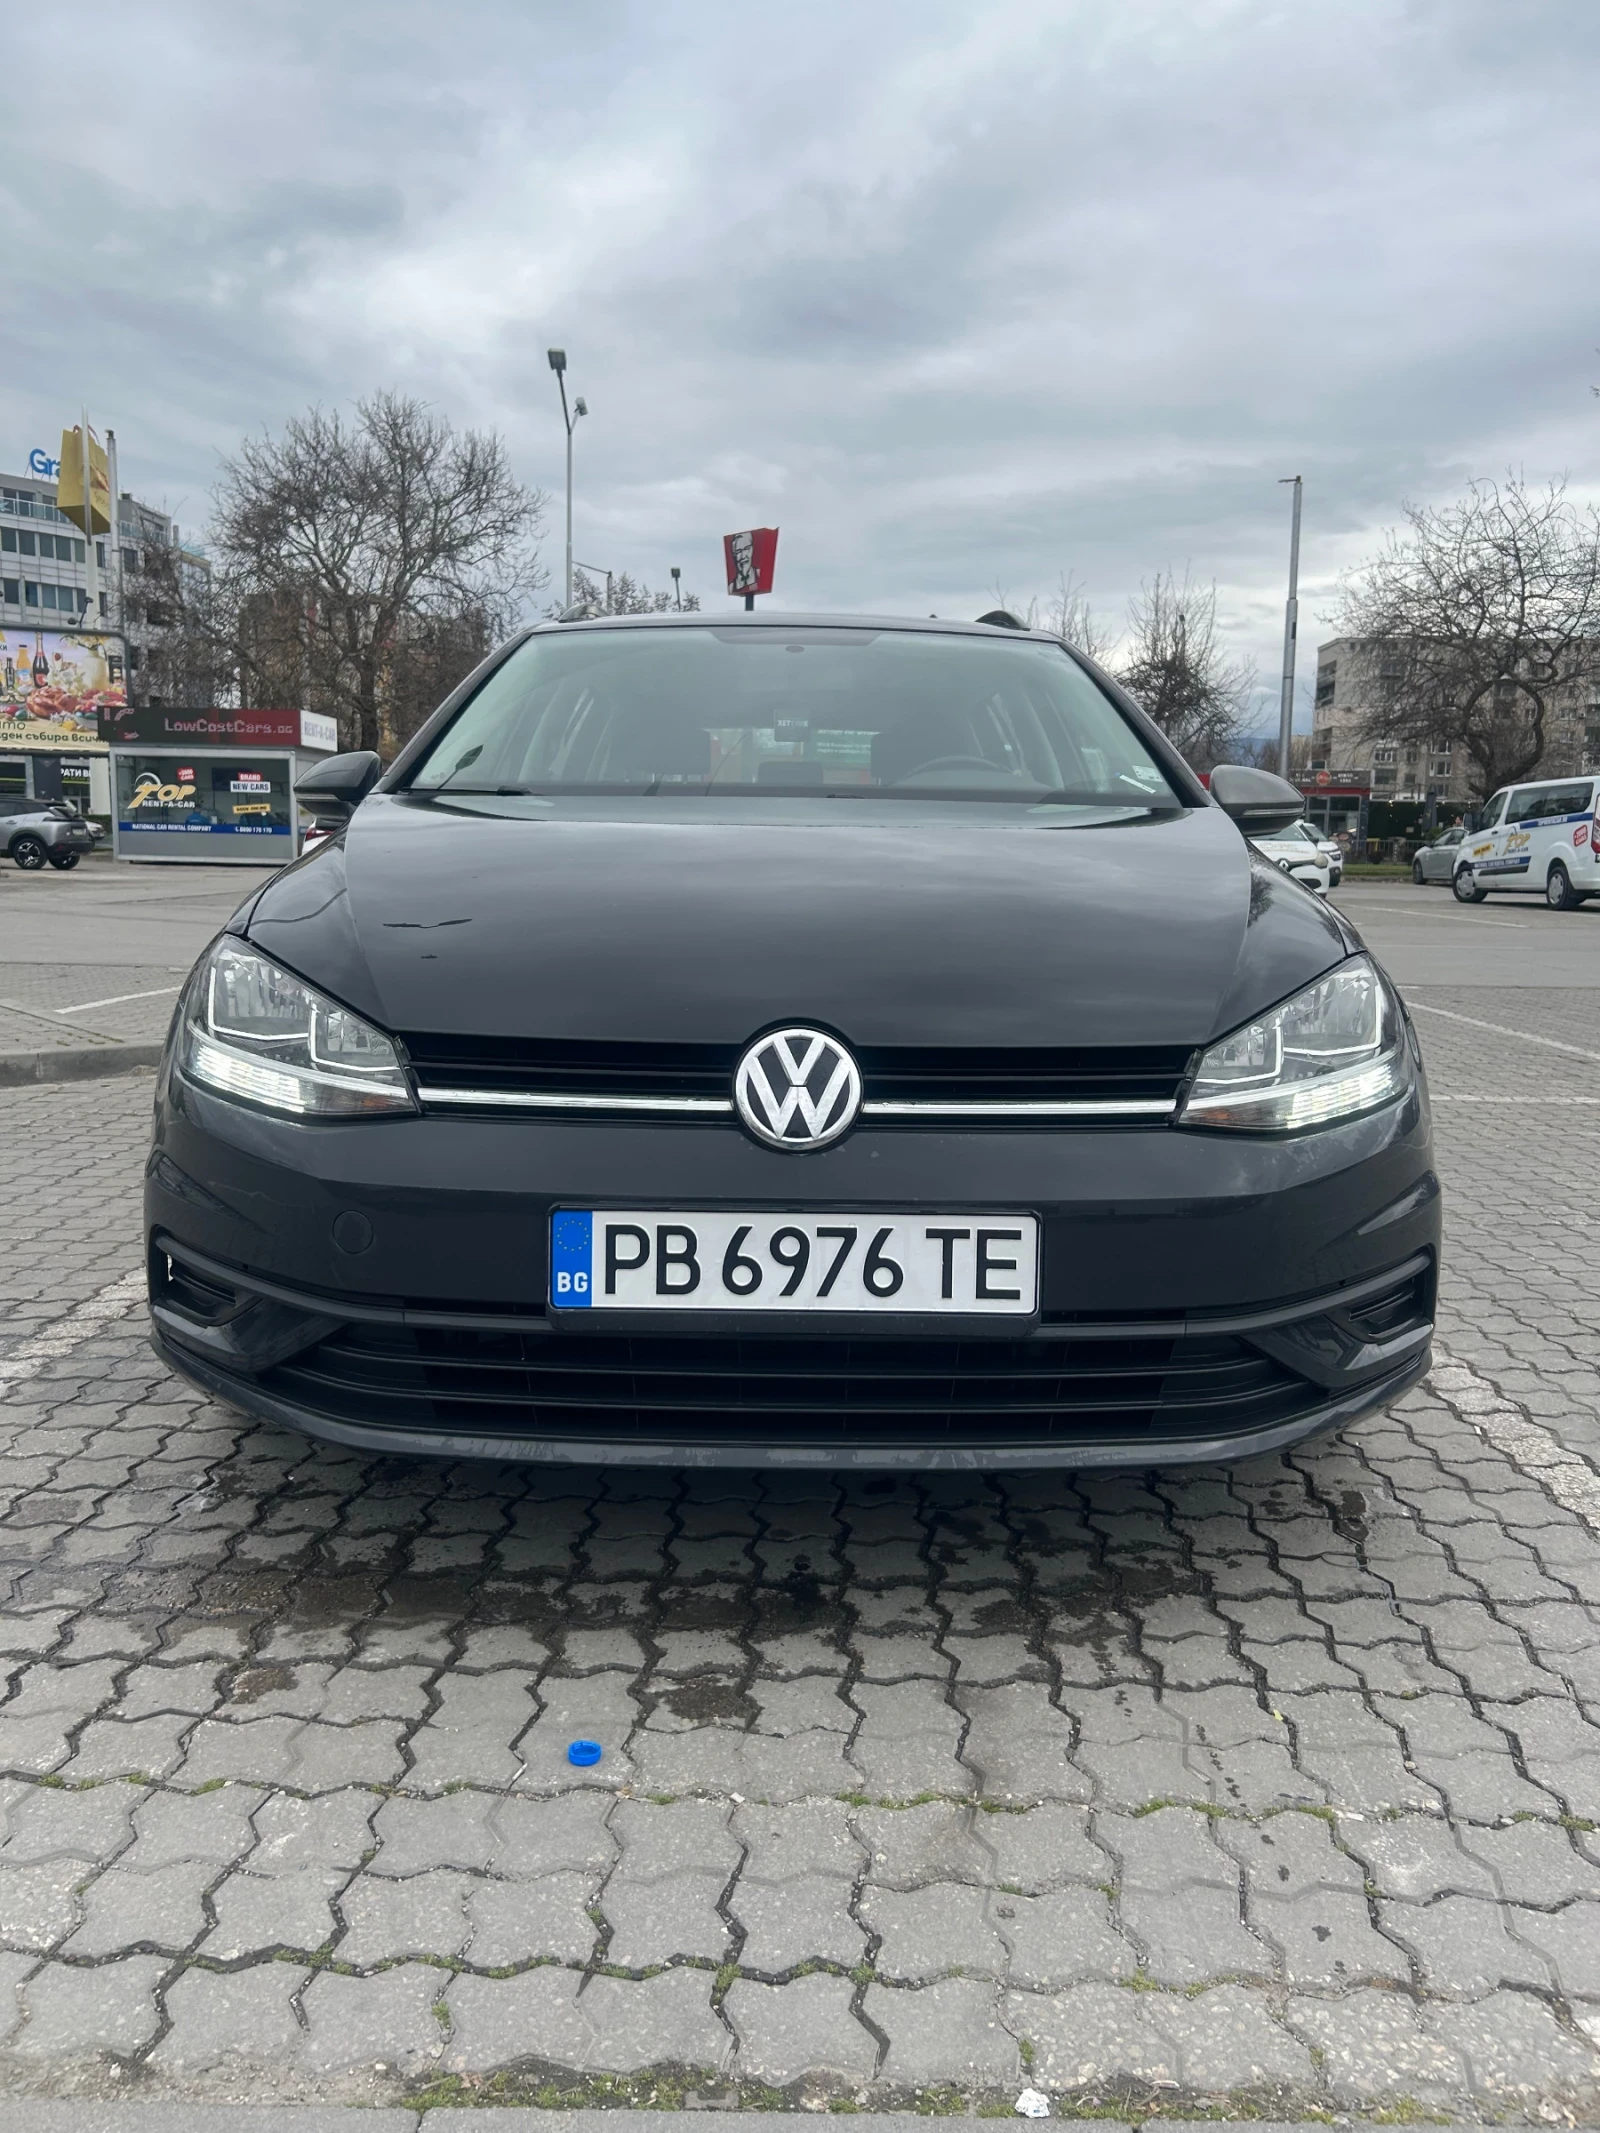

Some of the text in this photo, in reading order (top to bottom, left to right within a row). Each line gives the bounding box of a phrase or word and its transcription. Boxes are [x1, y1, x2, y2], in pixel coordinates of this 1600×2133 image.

[25, 732, 69, 744] събира
[72, 733, 108, 744] всич
[304, 721, 336, 742] RENT-A-CAR
[240, 773, 261, 781] BRAND
[232, 783, 269, 791] NEW CARS
[127, 783, 197, 810] TOP
[142, 800, 196, 809] RENT-A-CAR
[604, 1223, 1023, 1301] PB 6976 TE
[556, 1271, 589, 1294] BG
